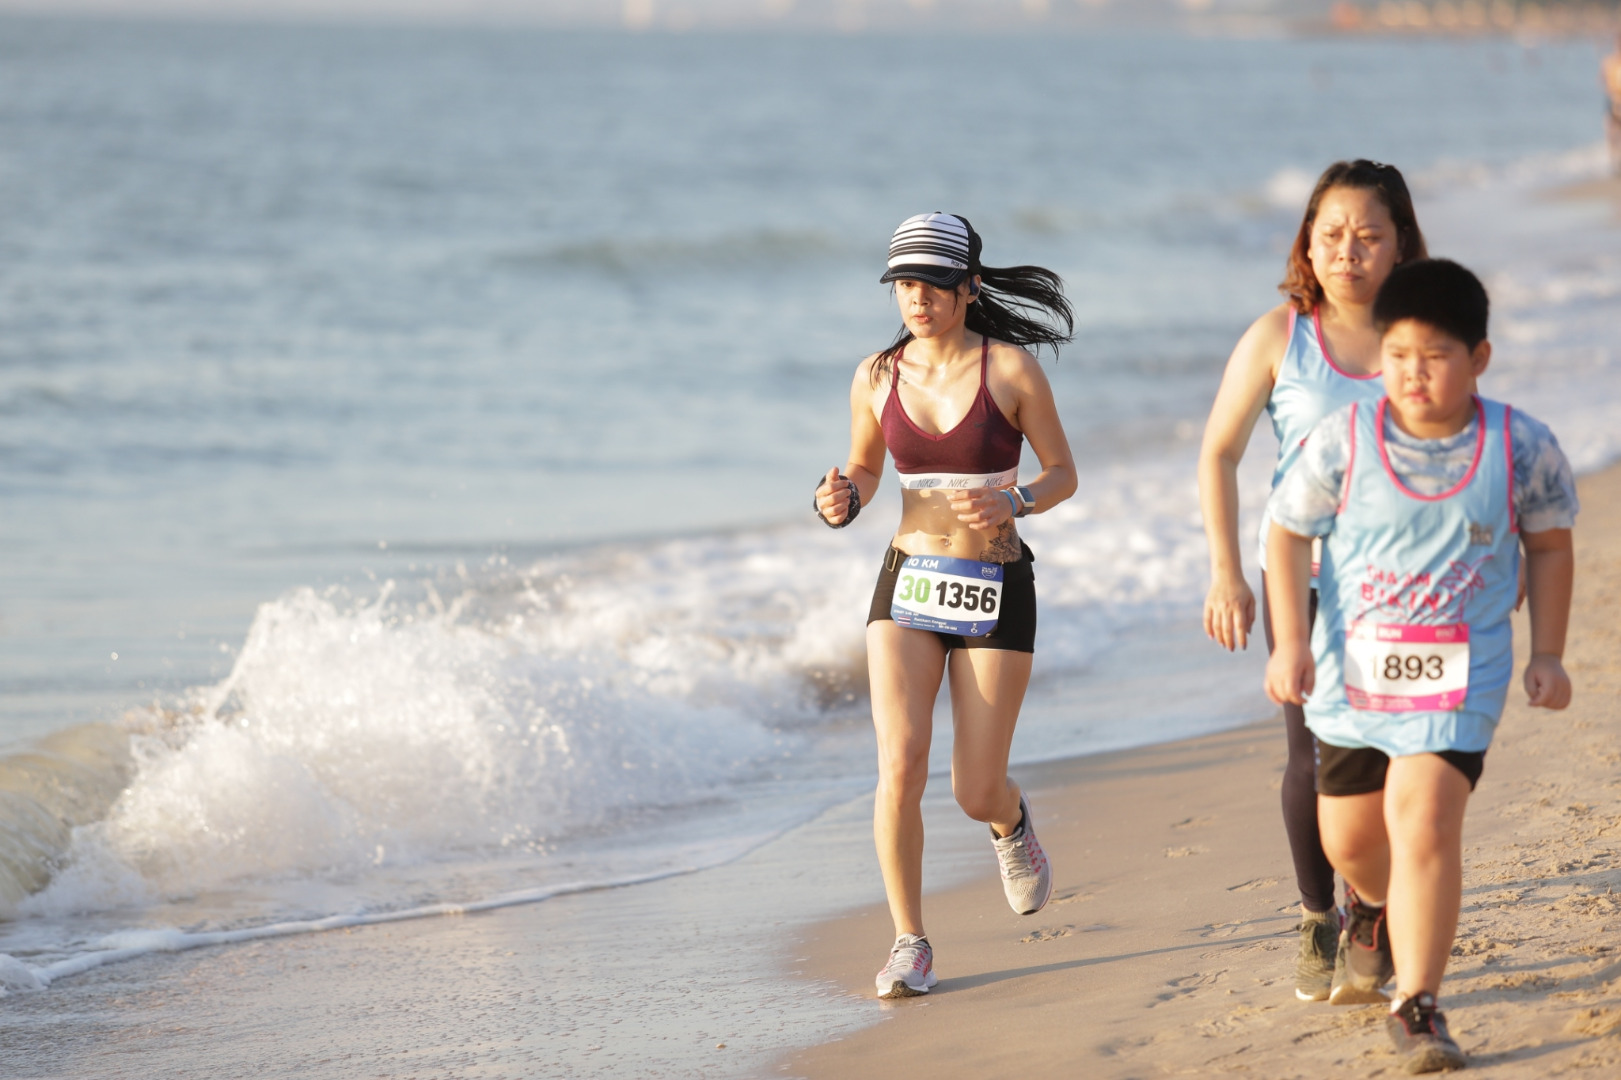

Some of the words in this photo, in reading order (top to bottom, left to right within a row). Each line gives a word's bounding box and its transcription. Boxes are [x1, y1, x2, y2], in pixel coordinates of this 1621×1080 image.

[917, 478, 935, 488] NIKE
[947, 478, 970, 488] NIKE
[984, 475, 1005, 488] NIKE
[908, 557, 919, 566] 10
[921, 558, 939, 569] KM
[898, 575, 931, 604] 30
[936, 581, 997, 613] 1356
